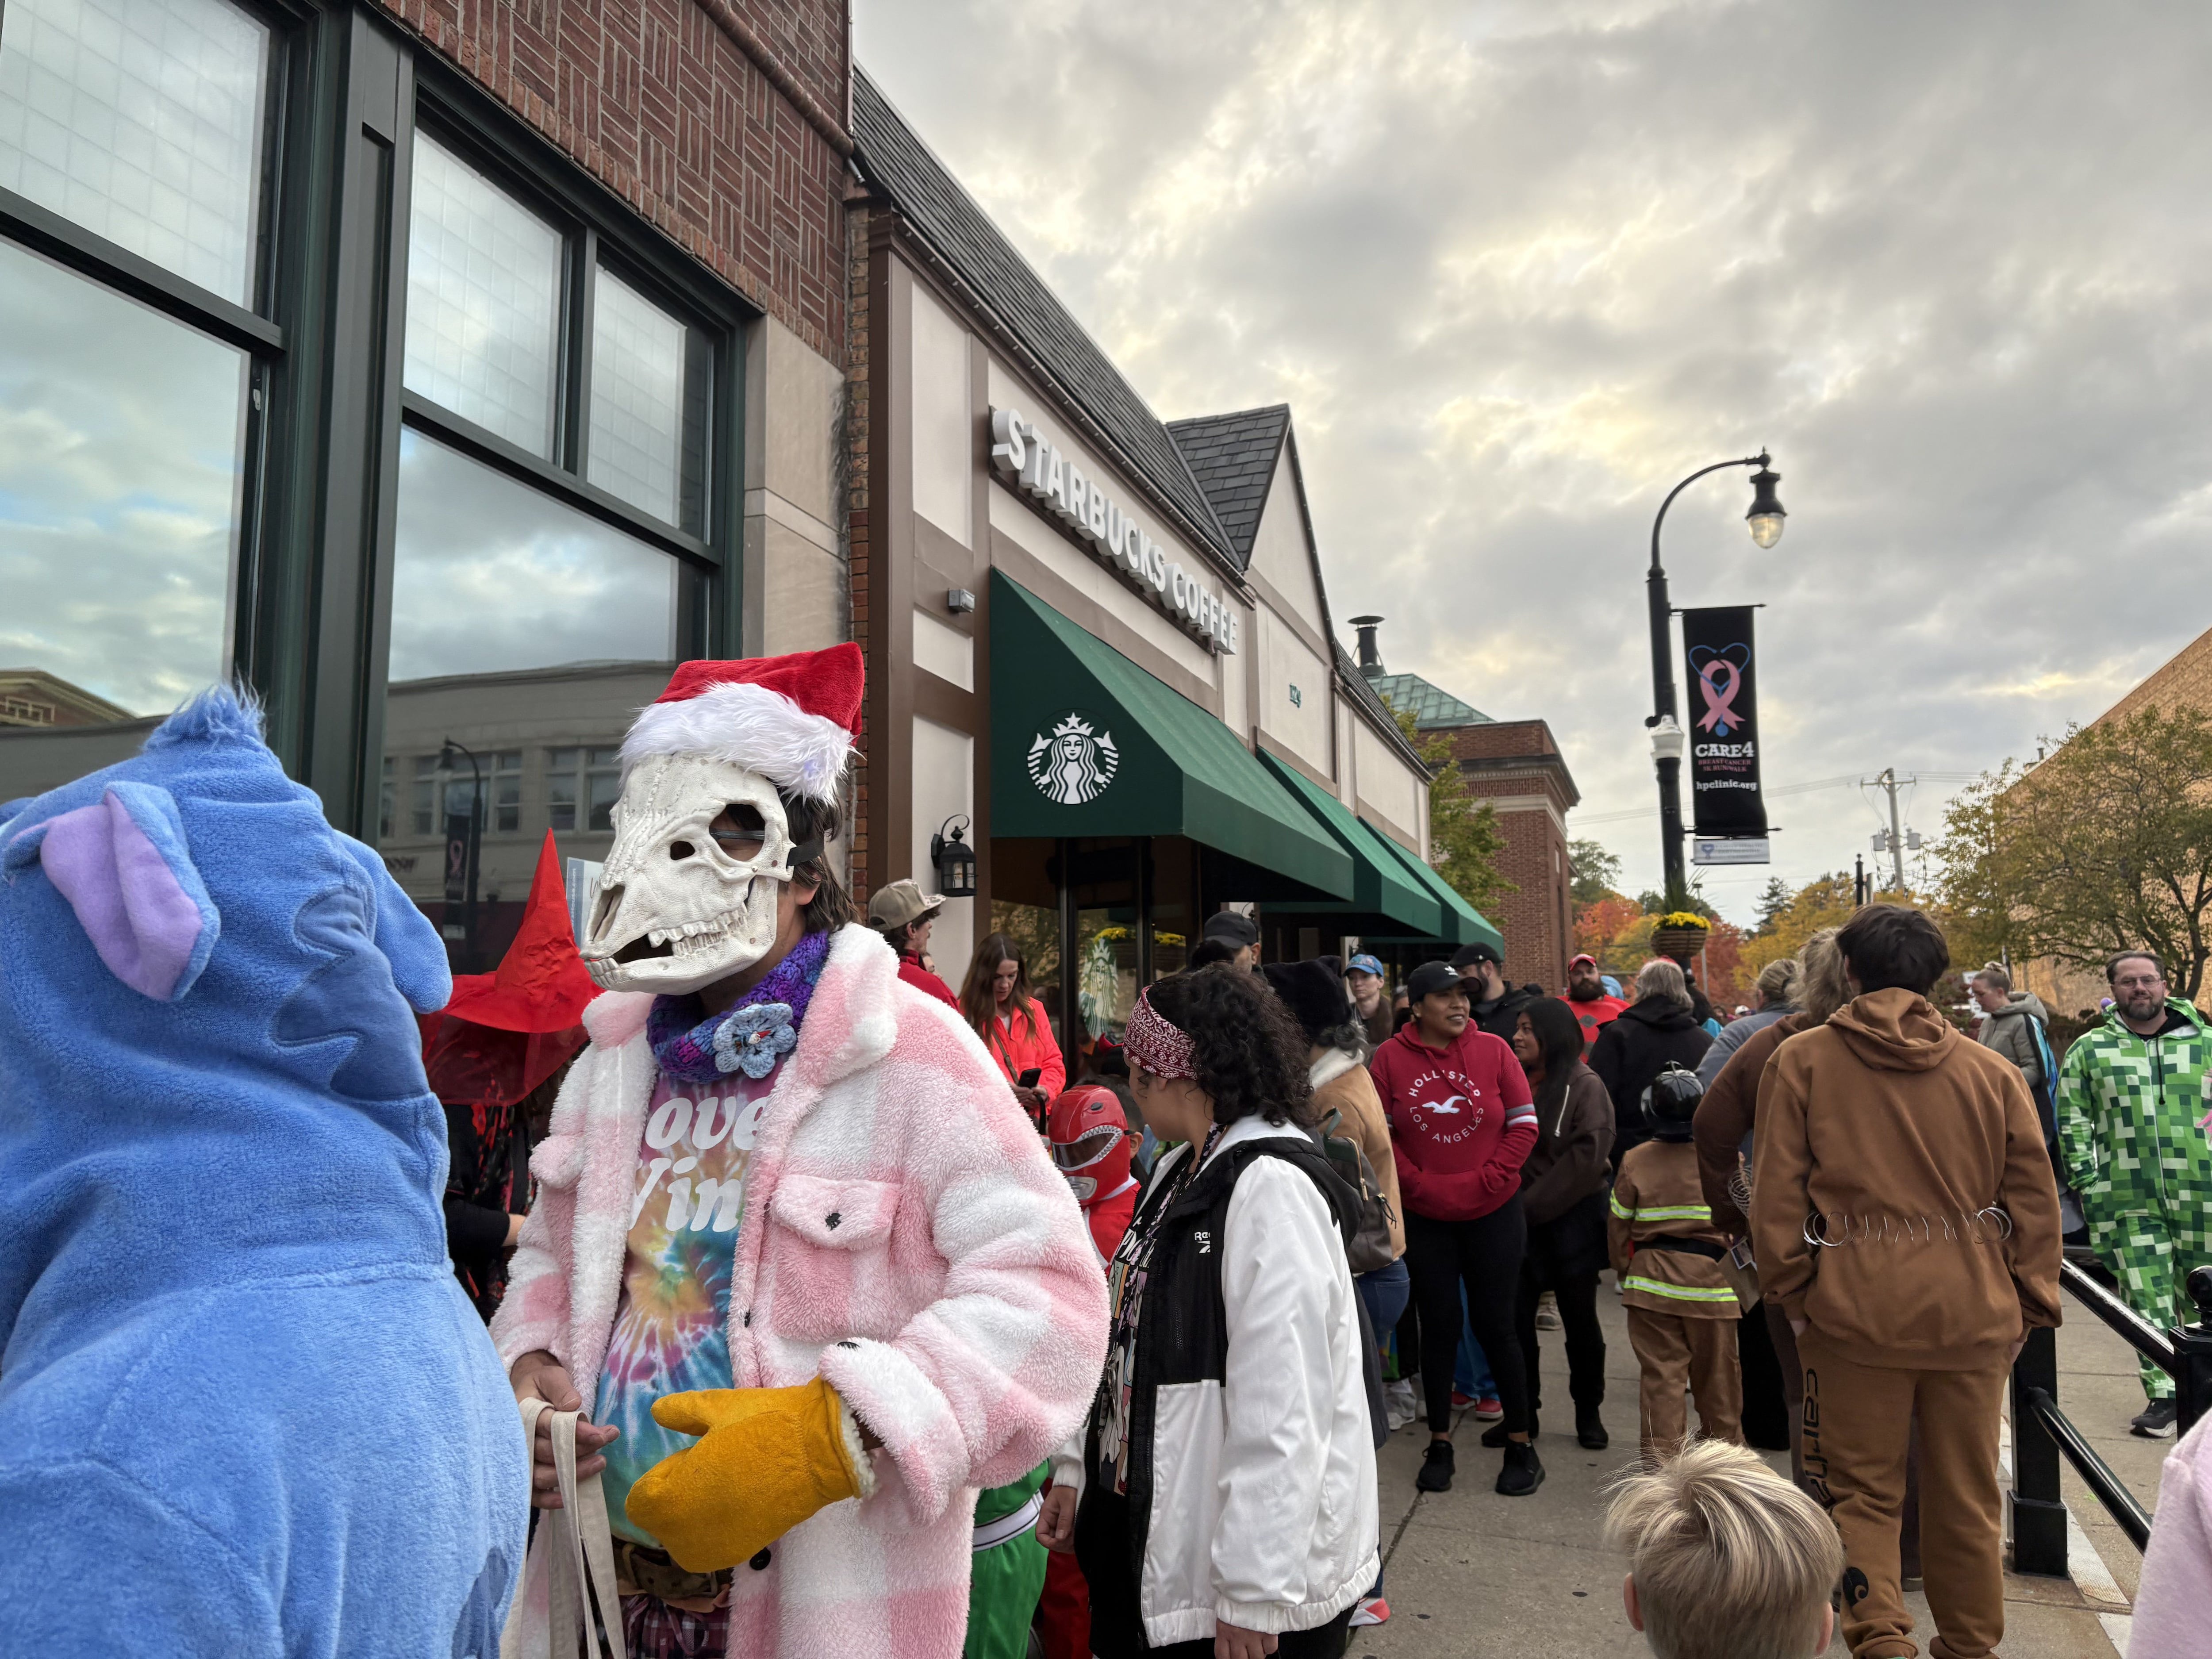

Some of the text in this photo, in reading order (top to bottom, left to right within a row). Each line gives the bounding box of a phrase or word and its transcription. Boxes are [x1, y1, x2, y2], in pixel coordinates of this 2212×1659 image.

[992, 408, 1238, 655] STARBUCKS COFFEE
[1695, 741, 1755, 758] CARE4
[1696, 779, 1758, 791] hpclinic.org
[1408, 1069, 1481, 1098] HOLLSTER
[645, 1096, 768, 1151] ove
[1409, 1106, 1484, 1144] LOS ANGELES
